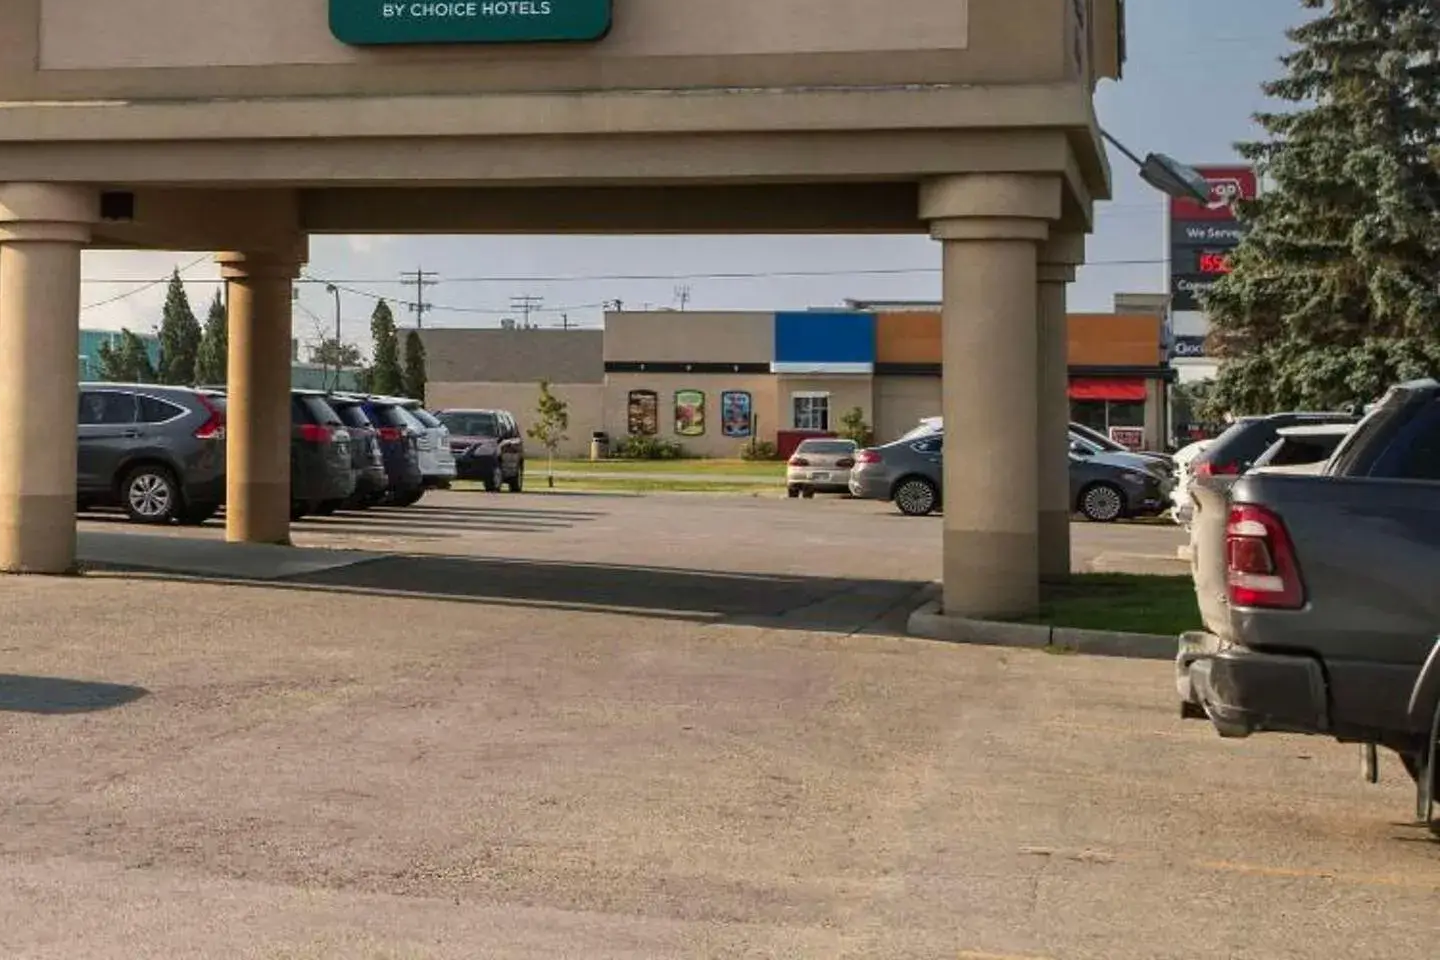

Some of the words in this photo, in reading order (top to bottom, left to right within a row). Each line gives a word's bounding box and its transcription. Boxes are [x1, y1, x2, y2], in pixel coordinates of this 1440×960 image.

[382, 2, 406, 18] BY
[410, 2, 477, 17] CHOICE
[482, 0, 551, 16] HOTELS
[1185, 227, 1205, 239] We
